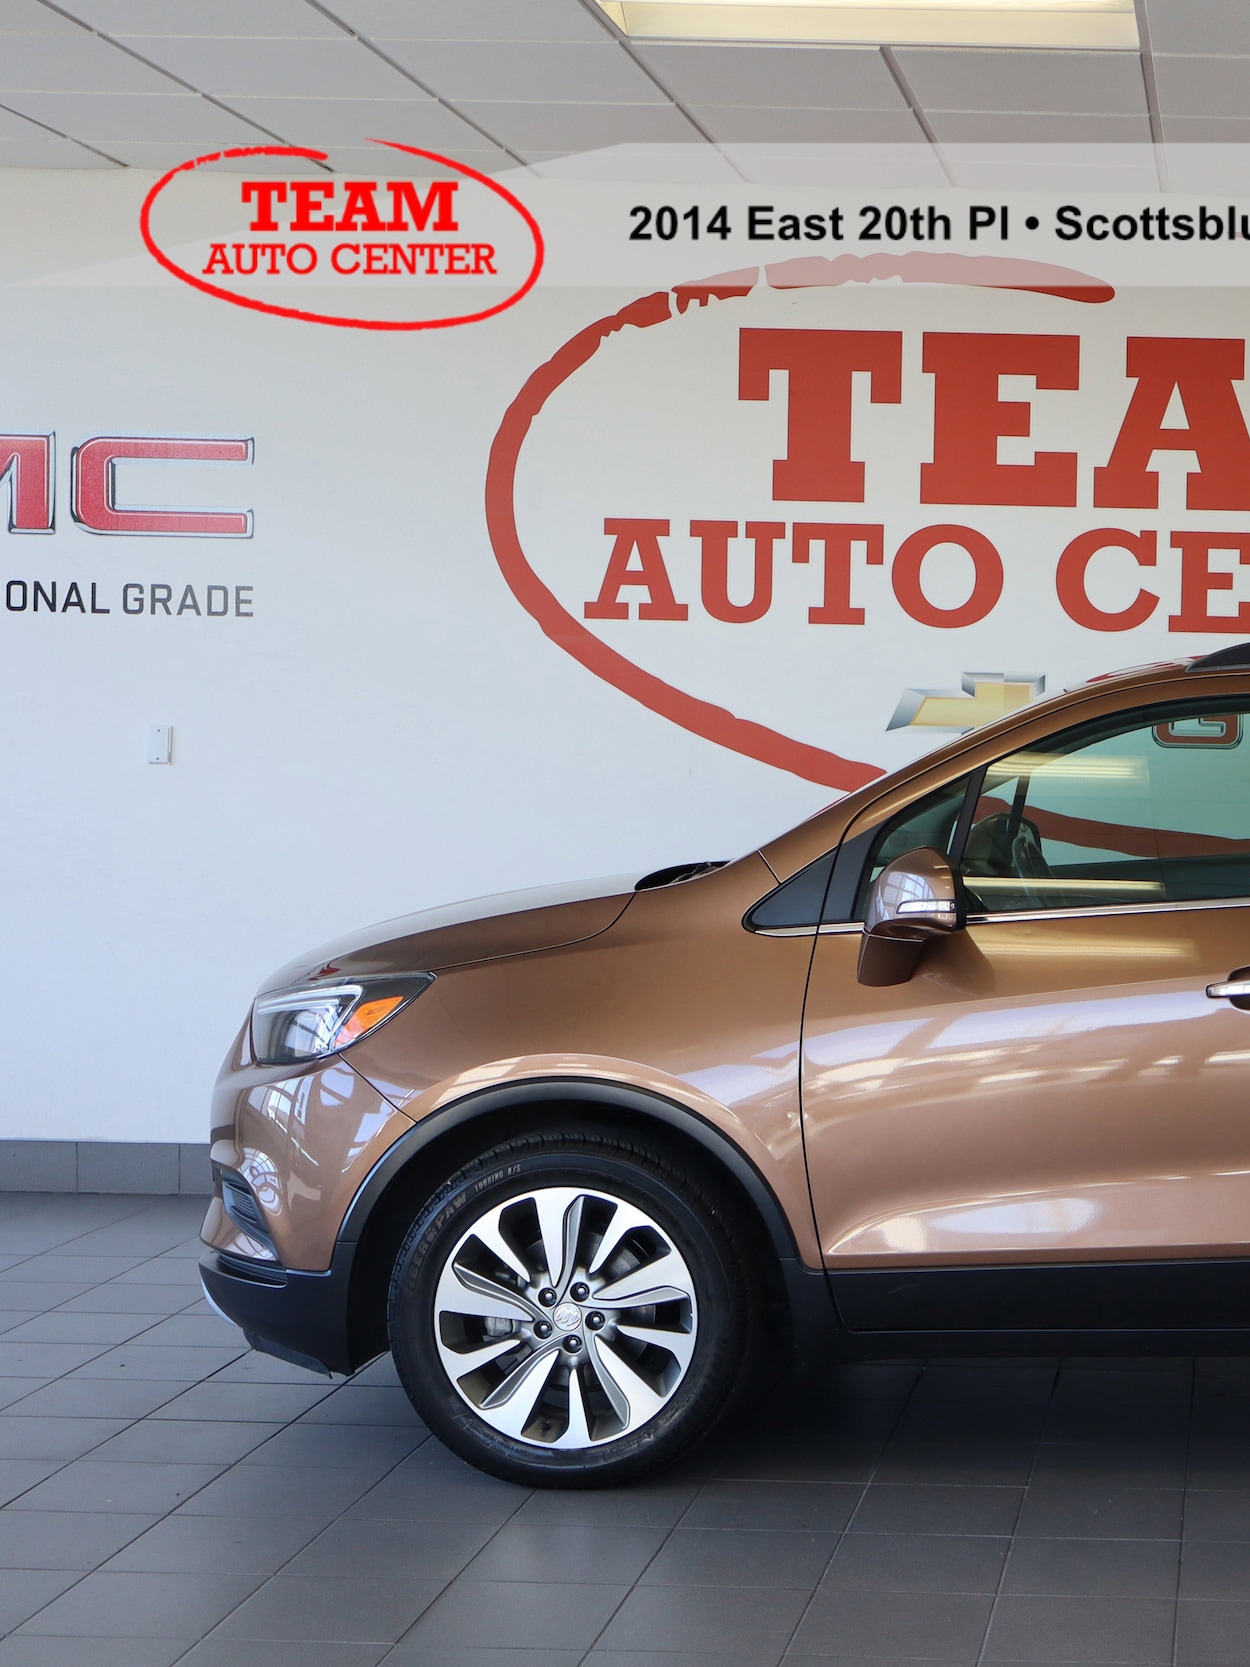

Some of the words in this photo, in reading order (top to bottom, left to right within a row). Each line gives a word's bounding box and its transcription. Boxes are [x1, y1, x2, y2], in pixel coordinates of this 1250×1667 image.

[122, 583, 254, 617] GRADE
[583, 518, 1005, 626] AUTO
[435, 1192, 468, 1229] PAW
[474, 1169, 504, 1193] TOURING
